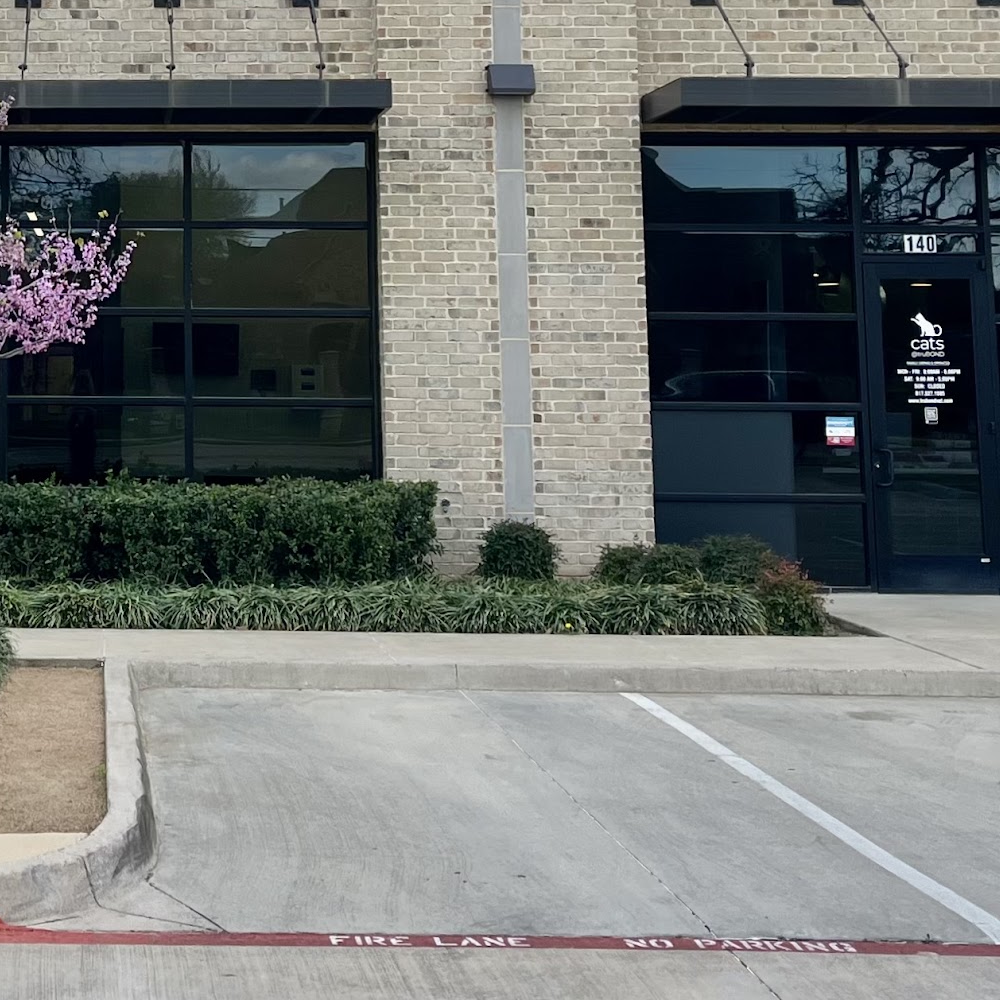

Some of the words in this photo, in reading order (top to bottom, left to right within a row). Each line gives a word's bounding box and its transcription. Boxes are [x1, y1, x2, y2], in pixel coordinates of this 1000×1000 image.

[907, 235, 936, 252] 140
[910, 337, 945, 350] cats
[329, 935, 413, 947] FIRE
[432, 936, 531, 947] LANE
[623, 938, 674, 949] NO
[693, 938, 858, 952] PARKING
